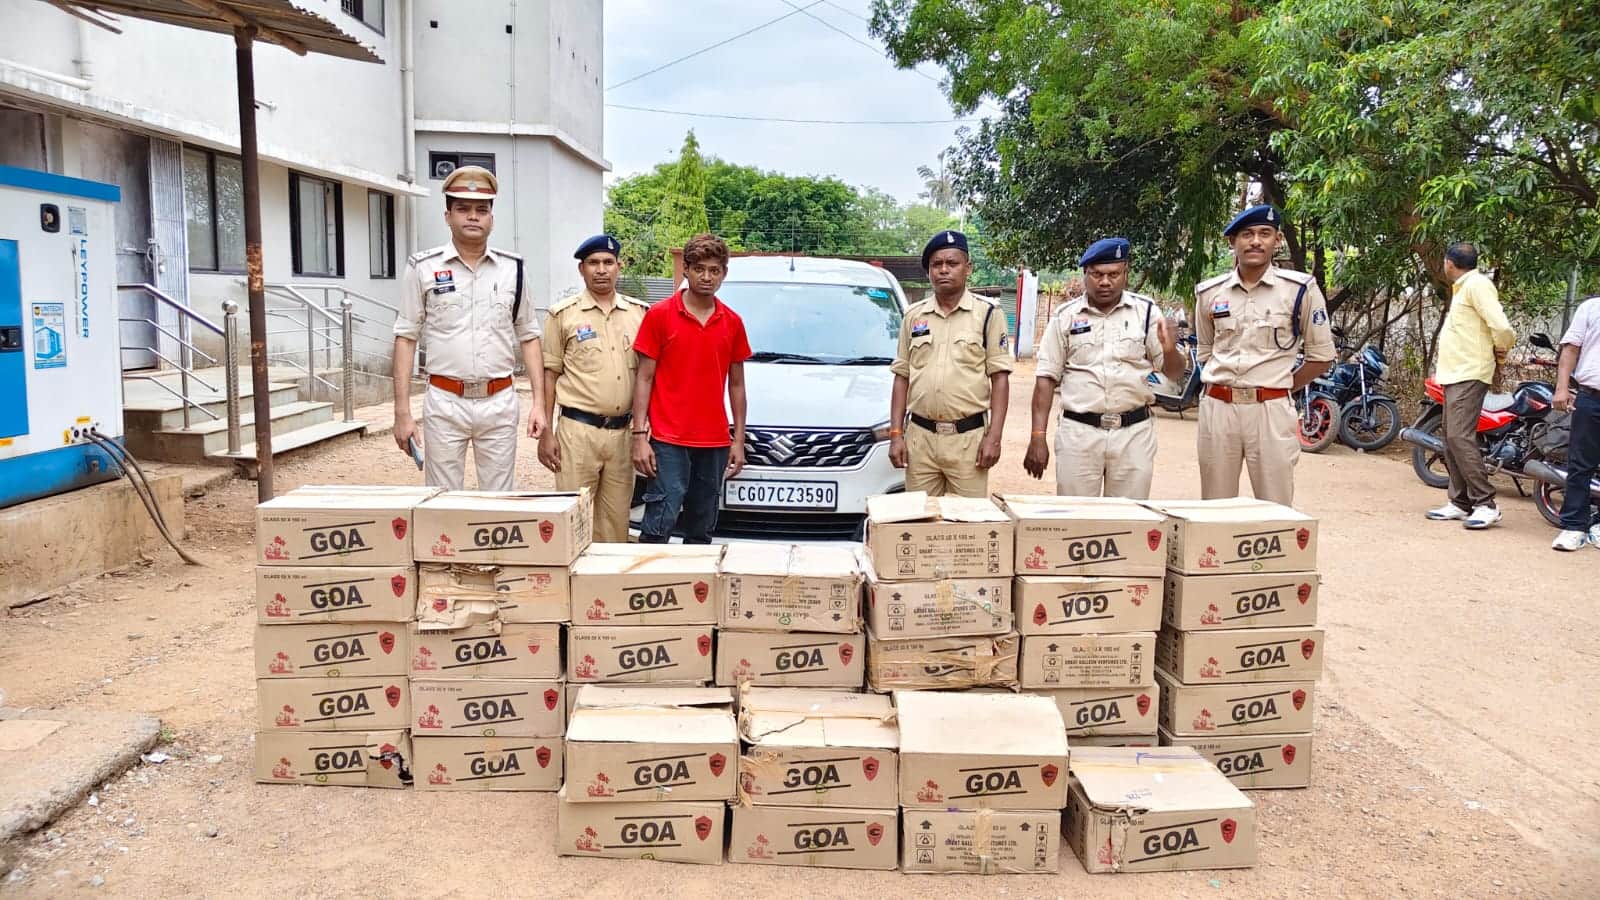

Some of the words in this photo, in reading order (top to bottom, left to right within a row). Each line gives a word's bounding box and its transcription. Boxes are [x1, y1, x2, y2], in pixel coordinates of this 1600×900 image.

[79, 239, 89, 338] LEYPOWER
[738, 485, 833, 503] CG07CZ3590
[310, 528, 365, 553] GOA
[473, 525, 524, 547] GOA
[1237, 535, 1282, 558] GOA
[1068, 538, 1120, 562] GOA
[310, 585, 364, 609] GOA
[629, 588, 678, 611] GOA
[1062, 594, 1109, 618] GOA
[1236, 590, 1280, 614] GOA
[313, 638, 365, 662] GOA
[455, 640, 507, 662] GOA
[618, 645, 671, 670] GOA
[775, 648, 825, 670] GOA
[1240, 645, 1286, 668] GOA
[319, 692, 370, 717] GOA
[464, 698, 516, 722] GOA
[1076, 701, 1121, 725] GOA
[1232, 698, 1277, 721] GOA
[315, 750, 363, 771] GOA
[471, 752, 520, 776] GOA
[1217, 752, 1264, 774] GOA
[634, 761, 689, 786] GOA
[783, 764, 841, 788] GOA
[966, 771, 1021, 794] GOA
[621, 821, 676, 844] GOA
[794, 827, 849, 849] GOA
[1143, 828, 1199, 855] GOA
